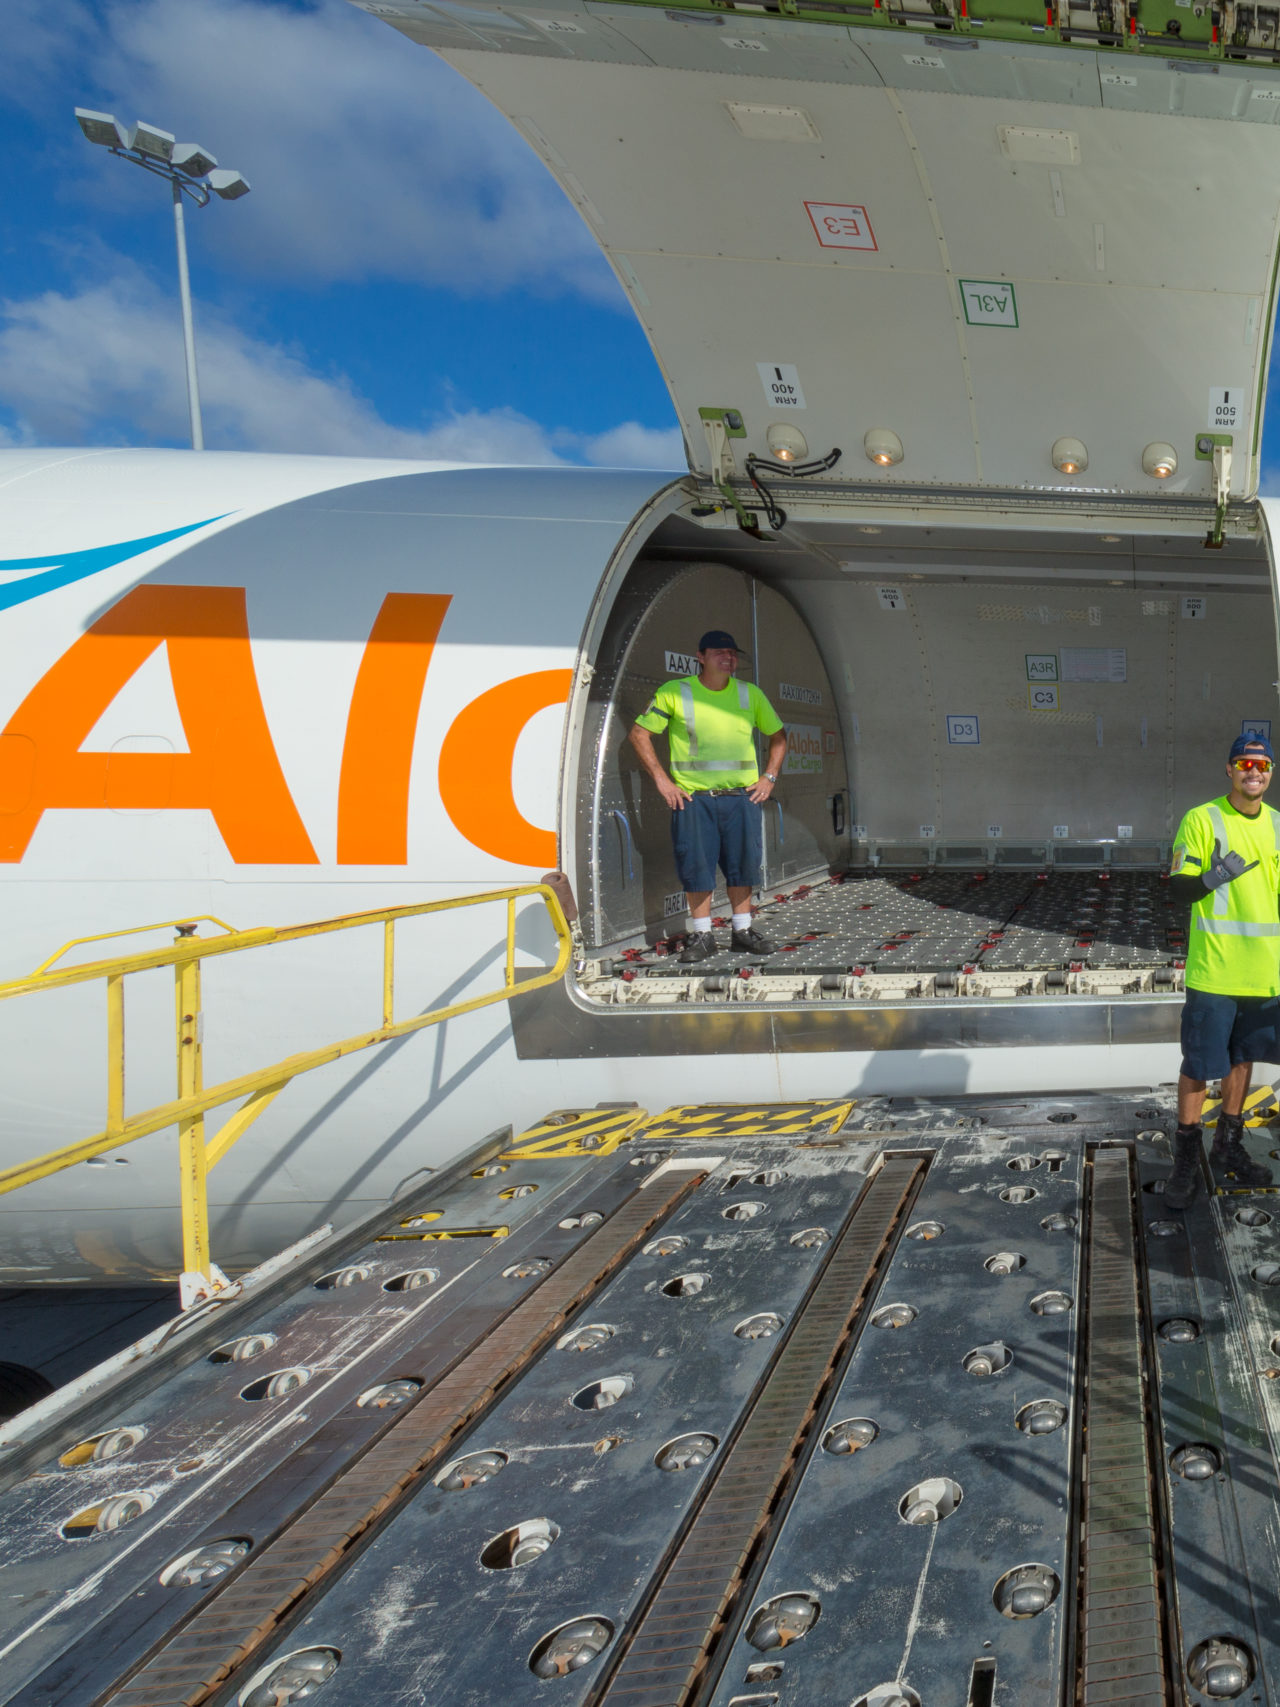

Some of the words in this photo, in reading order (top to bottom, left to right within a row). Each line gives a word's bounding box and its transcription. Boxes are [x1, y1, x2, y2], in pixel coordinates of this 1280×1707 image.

[823, 216, 861, 237] E3
[969, 293, 1008, 313] A3L
[771, 383, 795, 394] 400
[774, 395, 798, 405] ARM
[1215, 406, 1236, 416] 500
[1214, 418, 1236, 426] ARM
[669, 653, 692, 674] AAX
[1030, 662, 1054, 673] A3R
[1034, 691, 1054, 703] C3
[954, 723, 973, 736] D3
[787, 731, 821, 755] Aloha
[801, 756, 822, 773] Cargo
[665, 894, 680, 915] TARE
